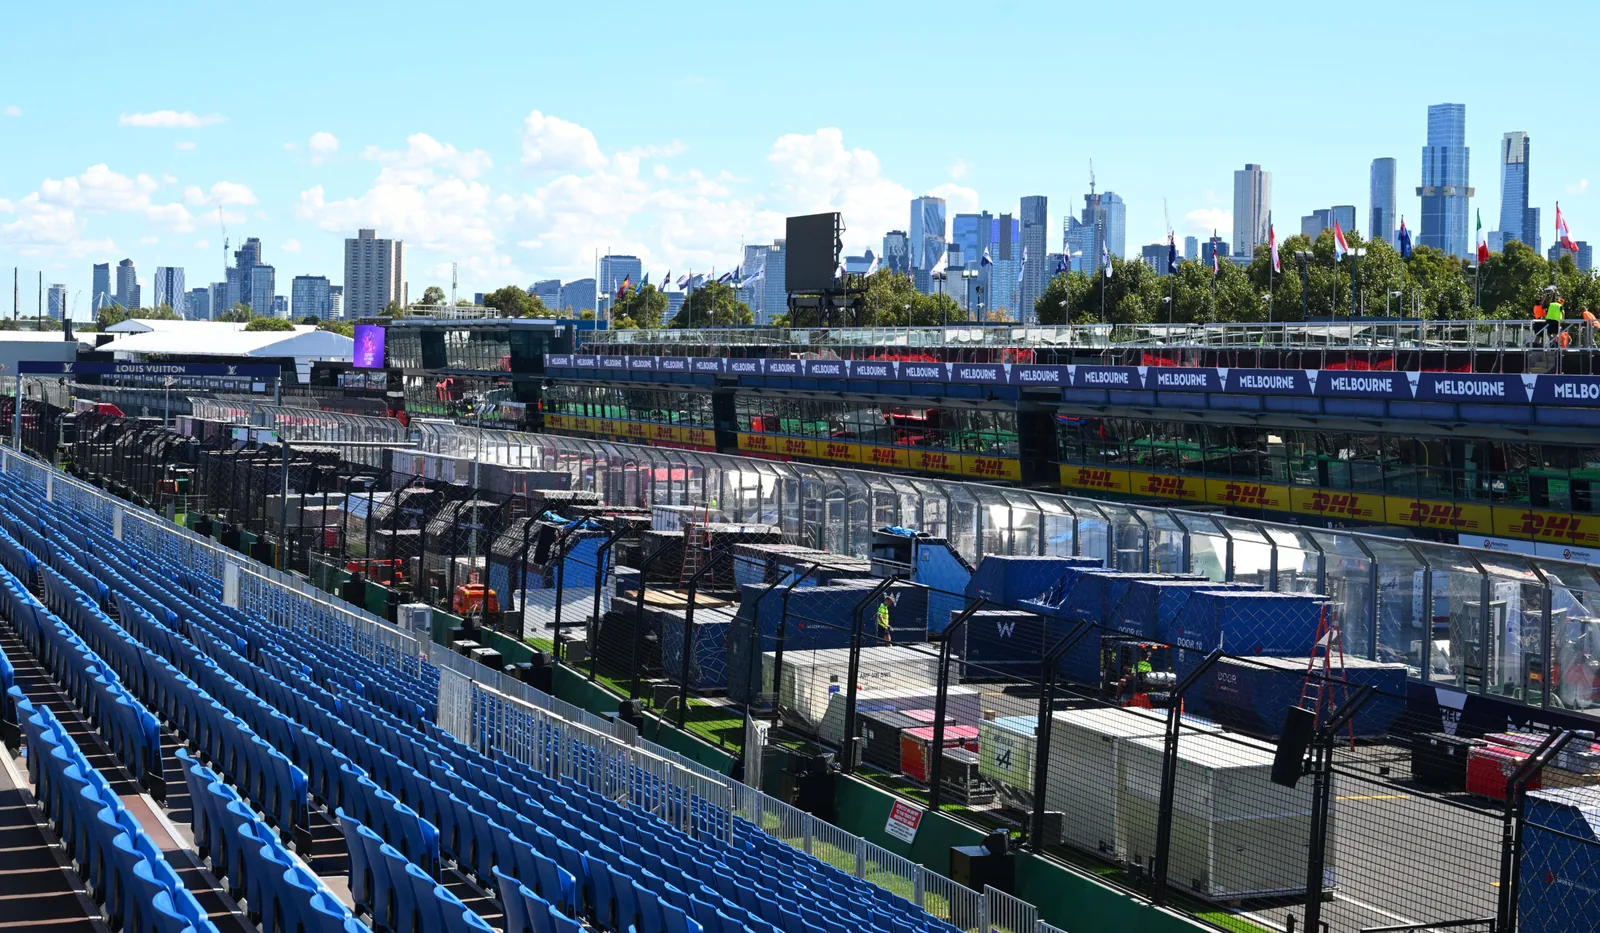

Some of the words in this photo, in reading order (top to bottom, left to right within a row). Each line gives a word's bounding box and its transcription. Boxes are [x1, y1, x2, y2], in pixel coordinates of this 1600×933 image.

[577, 358, 594, 366] MELBOURNE
[604, 359, 622, 367] MELBOURNE
[632, 360, 652, 368] MELBOURNE
[663, 360, 684, 369] MELBOURNE
[696, 361, 718, 371] MELBOURNE
[731, 362, 756, 372] MELBOURNE
[770, 363, 796, 373] MELBOURNE
[116, 364, 144, 373] LOUIS
[146, 365, 186, 373] VUITTON
[811, 364, 840, 374] MELBOURNE
[856, 365, 887, 376] MELBOURNE
[906, 366, 939, 378] MELBOURNE
[960, 368, 997, 380] MELBOURNE
[1020, 370, 1059, 382] MELBOURNE
[1085, 372, 1129, 384] MELBOURNE
[1158, 373, 1207, 386] MELBOURNE
[1240, 375, 1294, 389] MELBOURNE
[1331, 377, 1393, 392] MELBOURNE
[1435, 380, 1505, 396] MELBOURNE
[826, 444, 852, 460] DHL
[871, 448, 898, 464] DHL
[920, 453, 950, 470] DHL
[974, 459, 1006, 476] DHL
[1077, 469, 1114, 488] DHL
[1146, 476, 1189, 497] DHL
[1223, 483, 1272, 505] DHL
[1311, 492, 1363, 516] DHL
[1408, 502, 1468, 528] DHL
[1519, 512, 1587, 541] DHL
[996, 621, 1015, 638] W
[1119, 626, 1135, 635] DOOR
[1177, 637, 1195, 649] DOOR
[1217, 671, 1237, 684] DOOR
